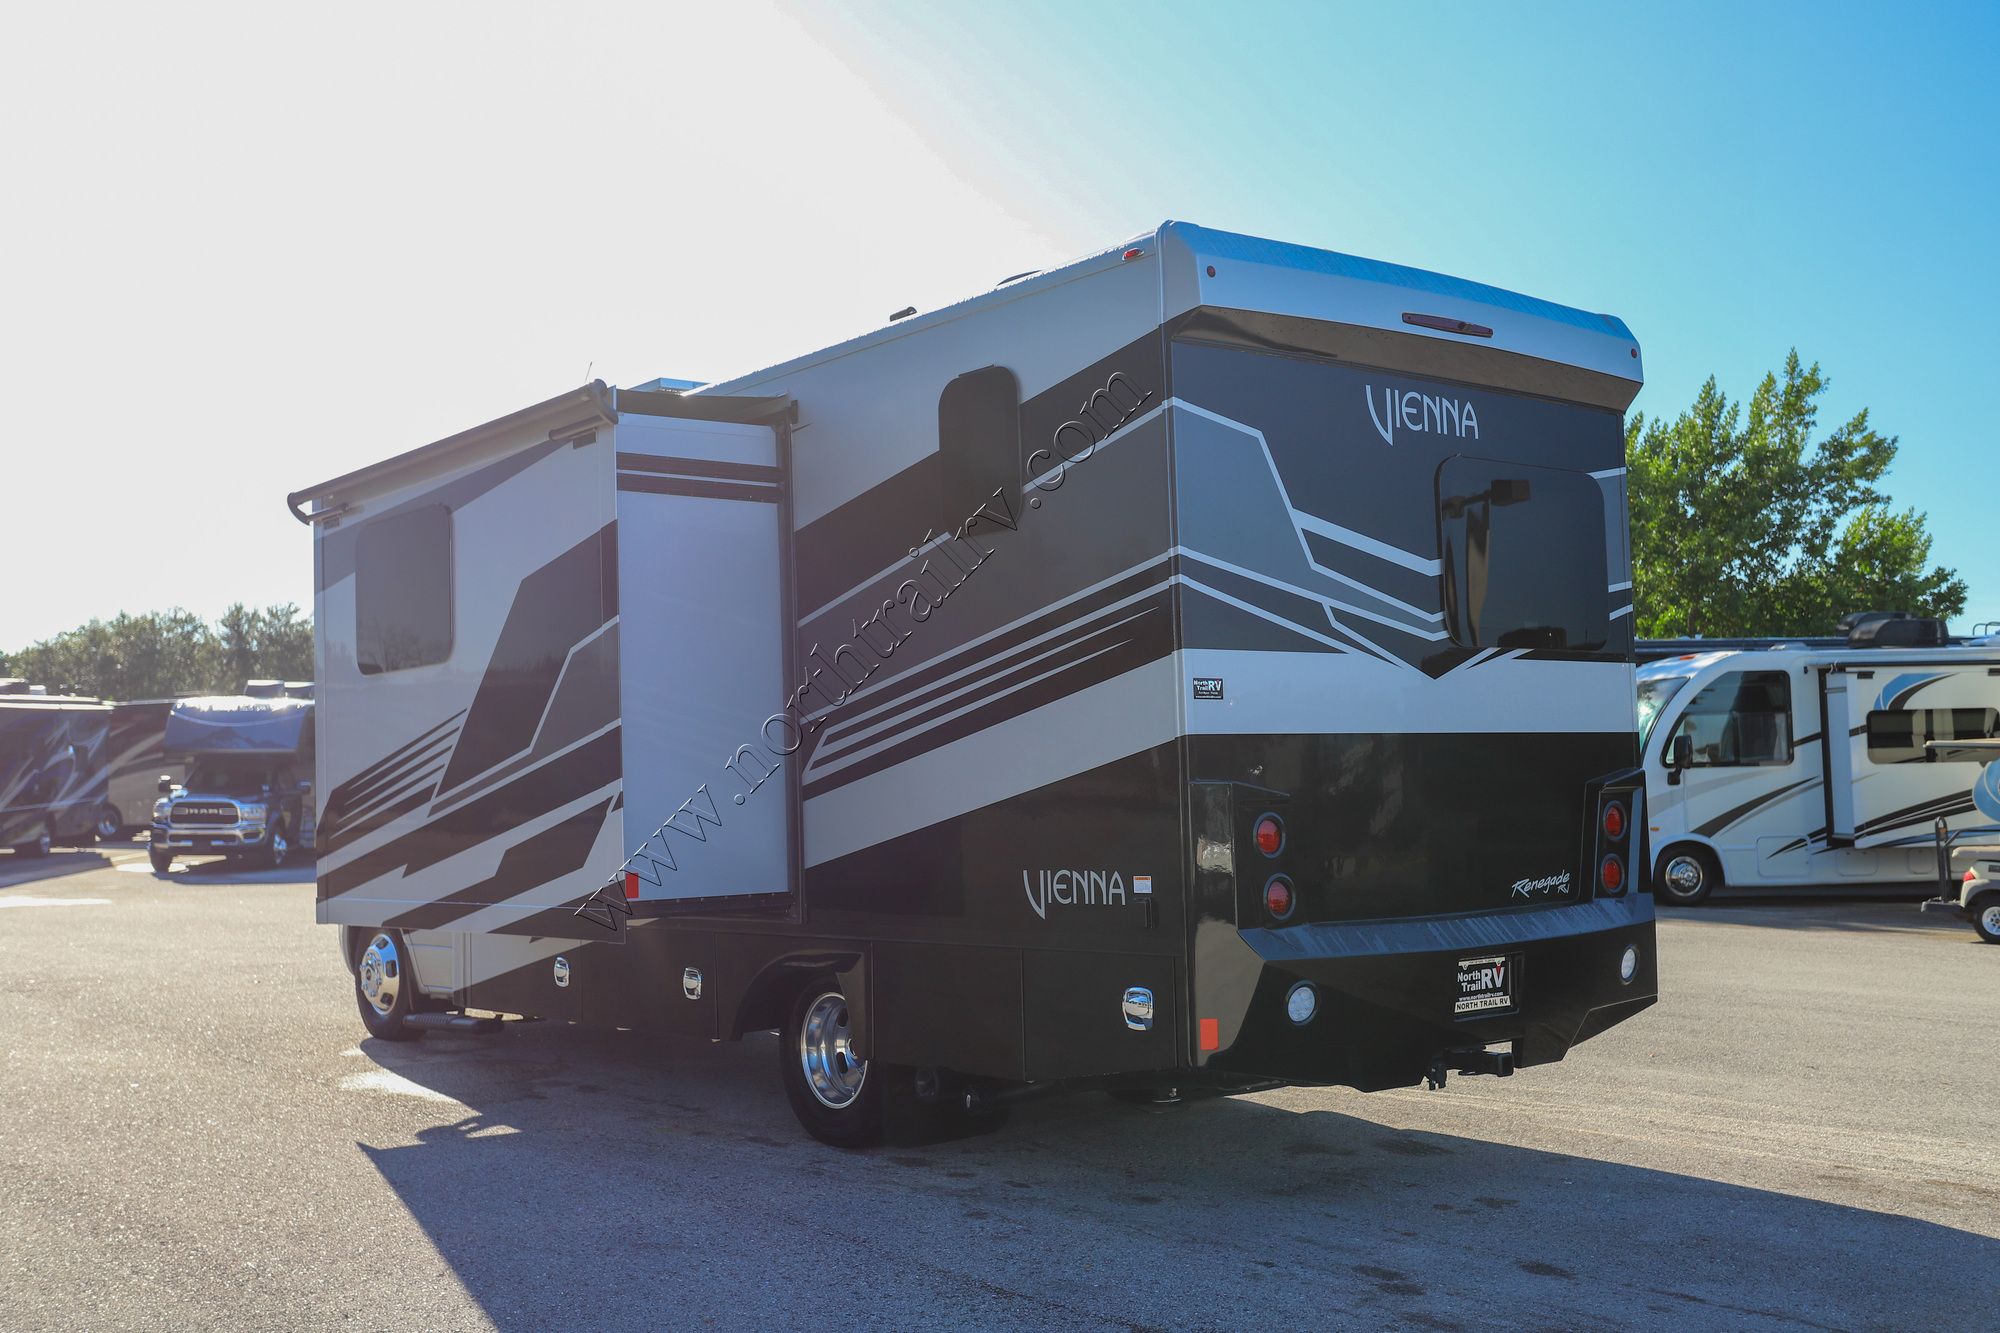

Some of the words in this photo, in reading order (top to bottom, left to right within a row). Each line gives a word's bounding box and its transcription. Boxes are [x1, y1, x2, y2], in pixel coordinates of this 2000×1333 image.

[1365, 384, 1479, 446] VIENNA
[1208, 680, 1222, 691] RV
[1511, 869, 1571, 898] Renegade
[1557, 884, 1570, 894] RV
[1023, 869, 1126, 920] VIENNA
[1457, 970, 1481, 983] North
[1481, 967, 1505, 990] RV
[1461, 980, 1481, 992] Trail
[1456, 1001, 1479, 1011] NORTH
[1480, 998, 1498, 1008] TRAIL
[1500, 997, 1509, 1005] RV
